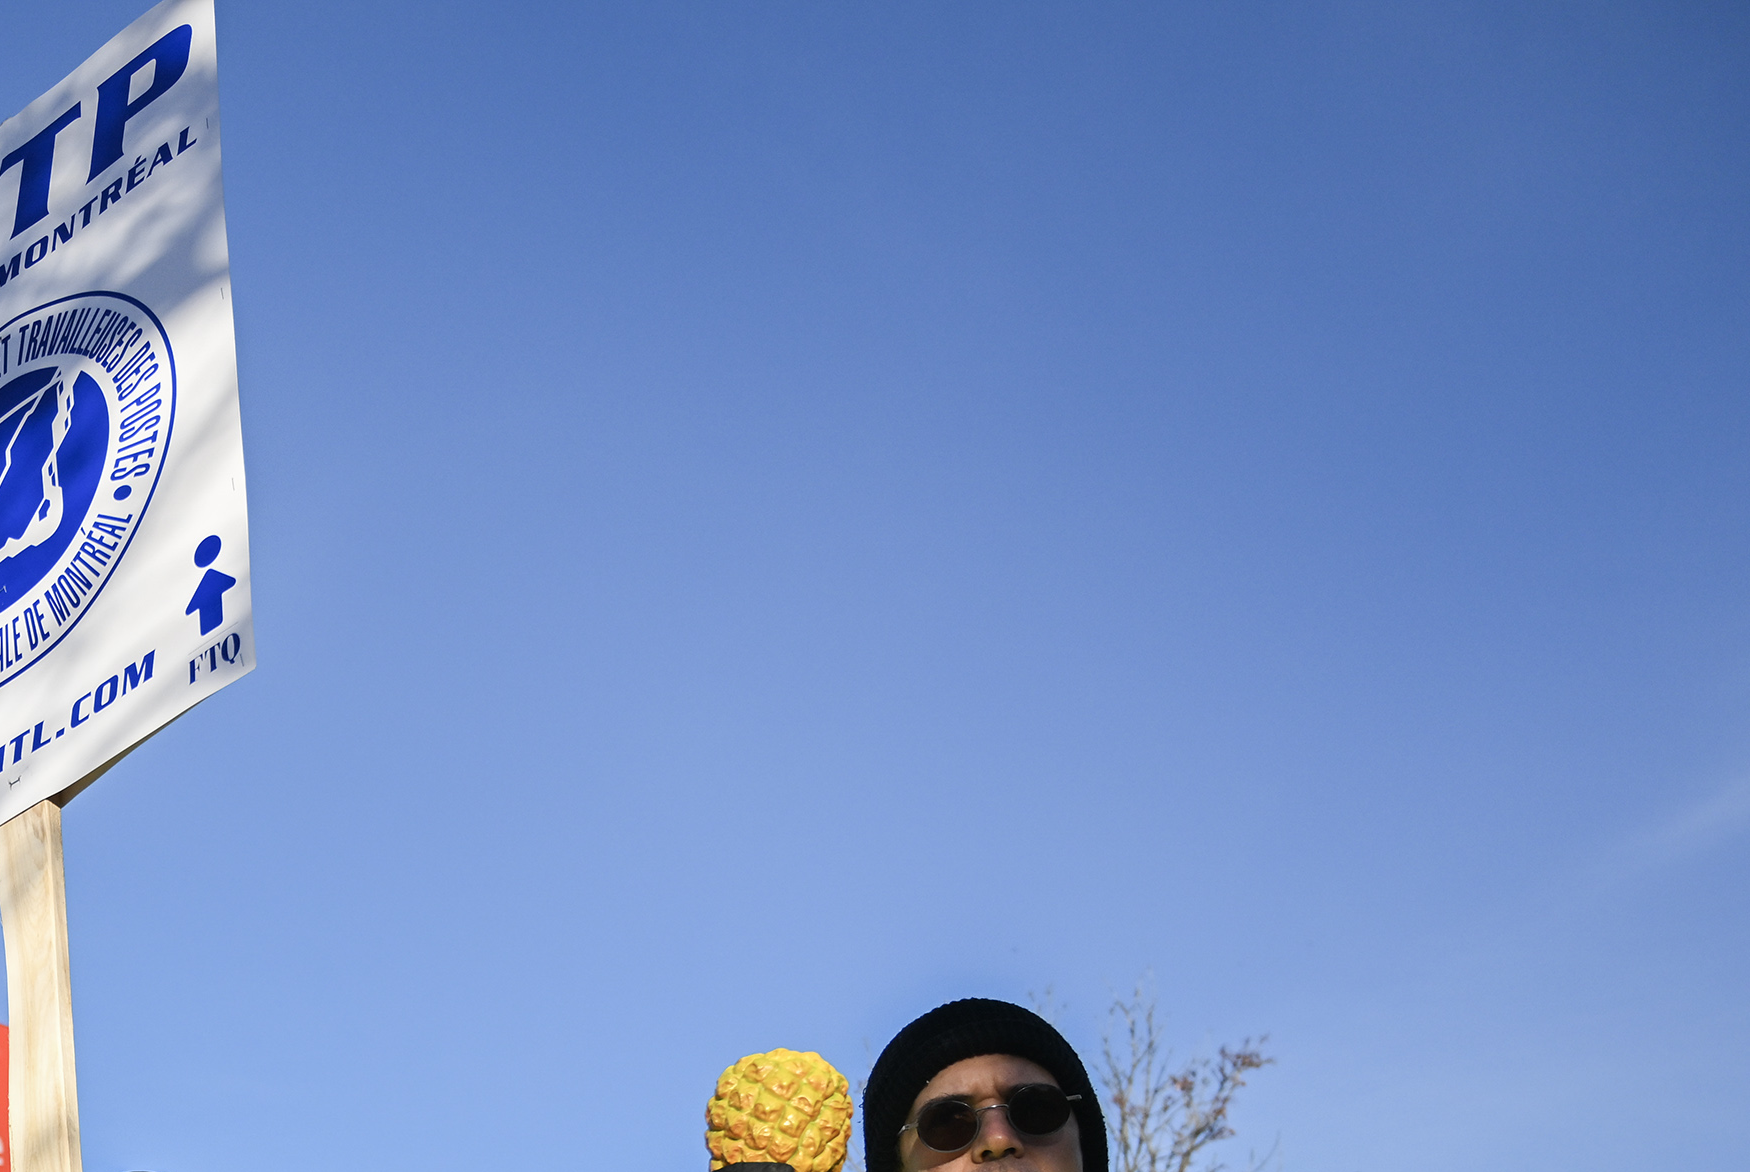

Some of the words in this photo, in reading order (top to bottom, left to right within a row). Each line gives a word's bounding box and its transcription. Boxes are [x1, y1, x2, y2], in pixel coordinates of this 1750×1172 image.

[17, 306, 141, 374] TRAVAILLEUSES
[111, 341, 161, 401] DES
[110, 382, 162, 482] POSTES
[23, 603, 50, 648] DE
[43, 513, 133, 627] MONTRÉAL
[188, 632, 242, 685] FTQ
